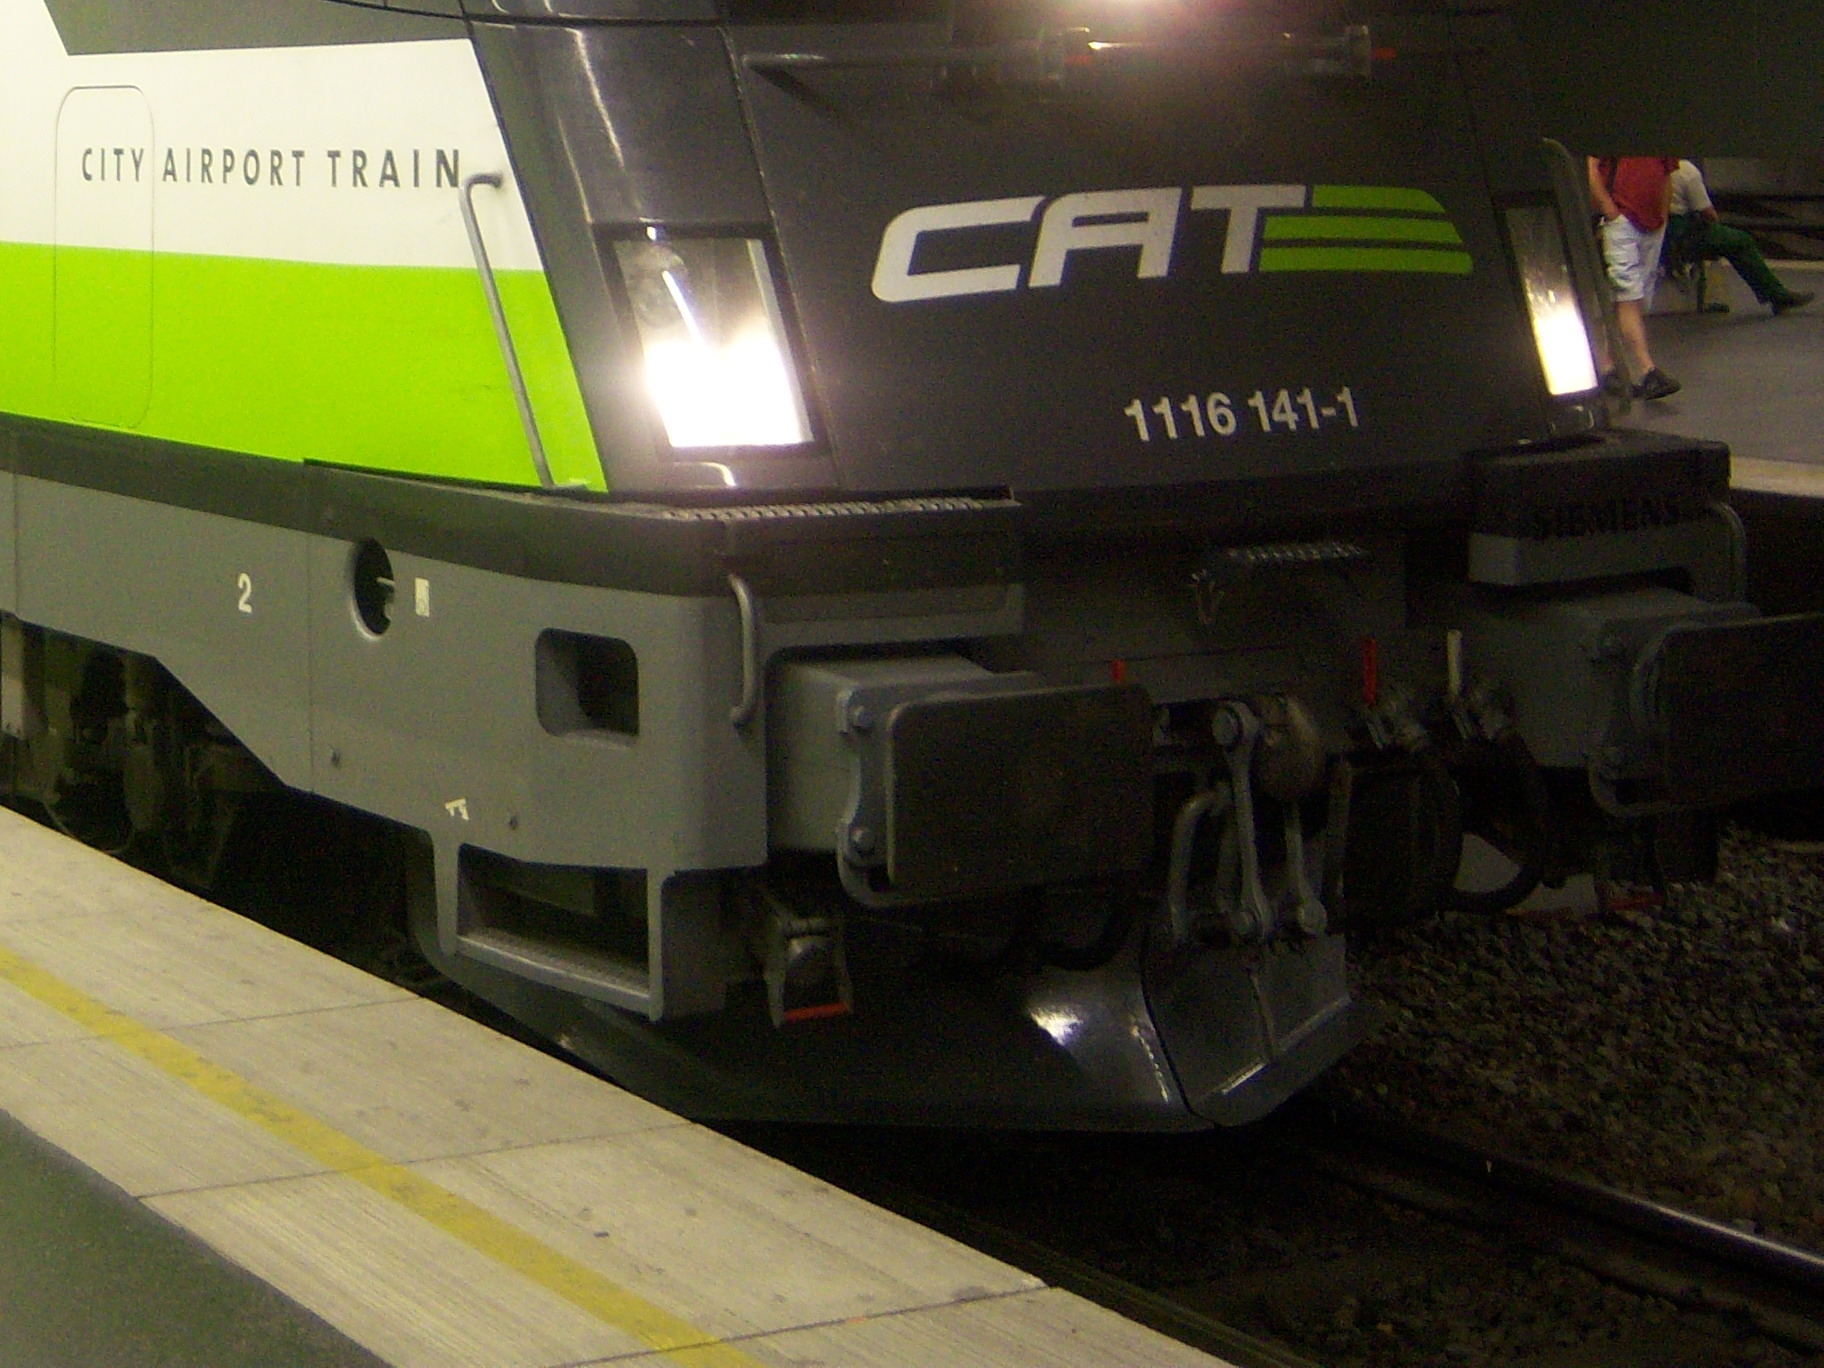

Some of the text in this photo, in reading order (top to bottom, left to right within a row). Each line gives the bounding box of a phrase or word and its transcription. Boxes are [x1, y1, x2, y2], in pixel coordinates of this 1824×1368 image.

[81, 147, 460, 188] CITY AIRPORT TRAIN
[871, 184, 1305, 303] CAT
[1124, 386, 1360, 443] 1116 141-1
[1533, 496, 1679, 539] SIEMENS
[237, 572, 253, 614] 2
